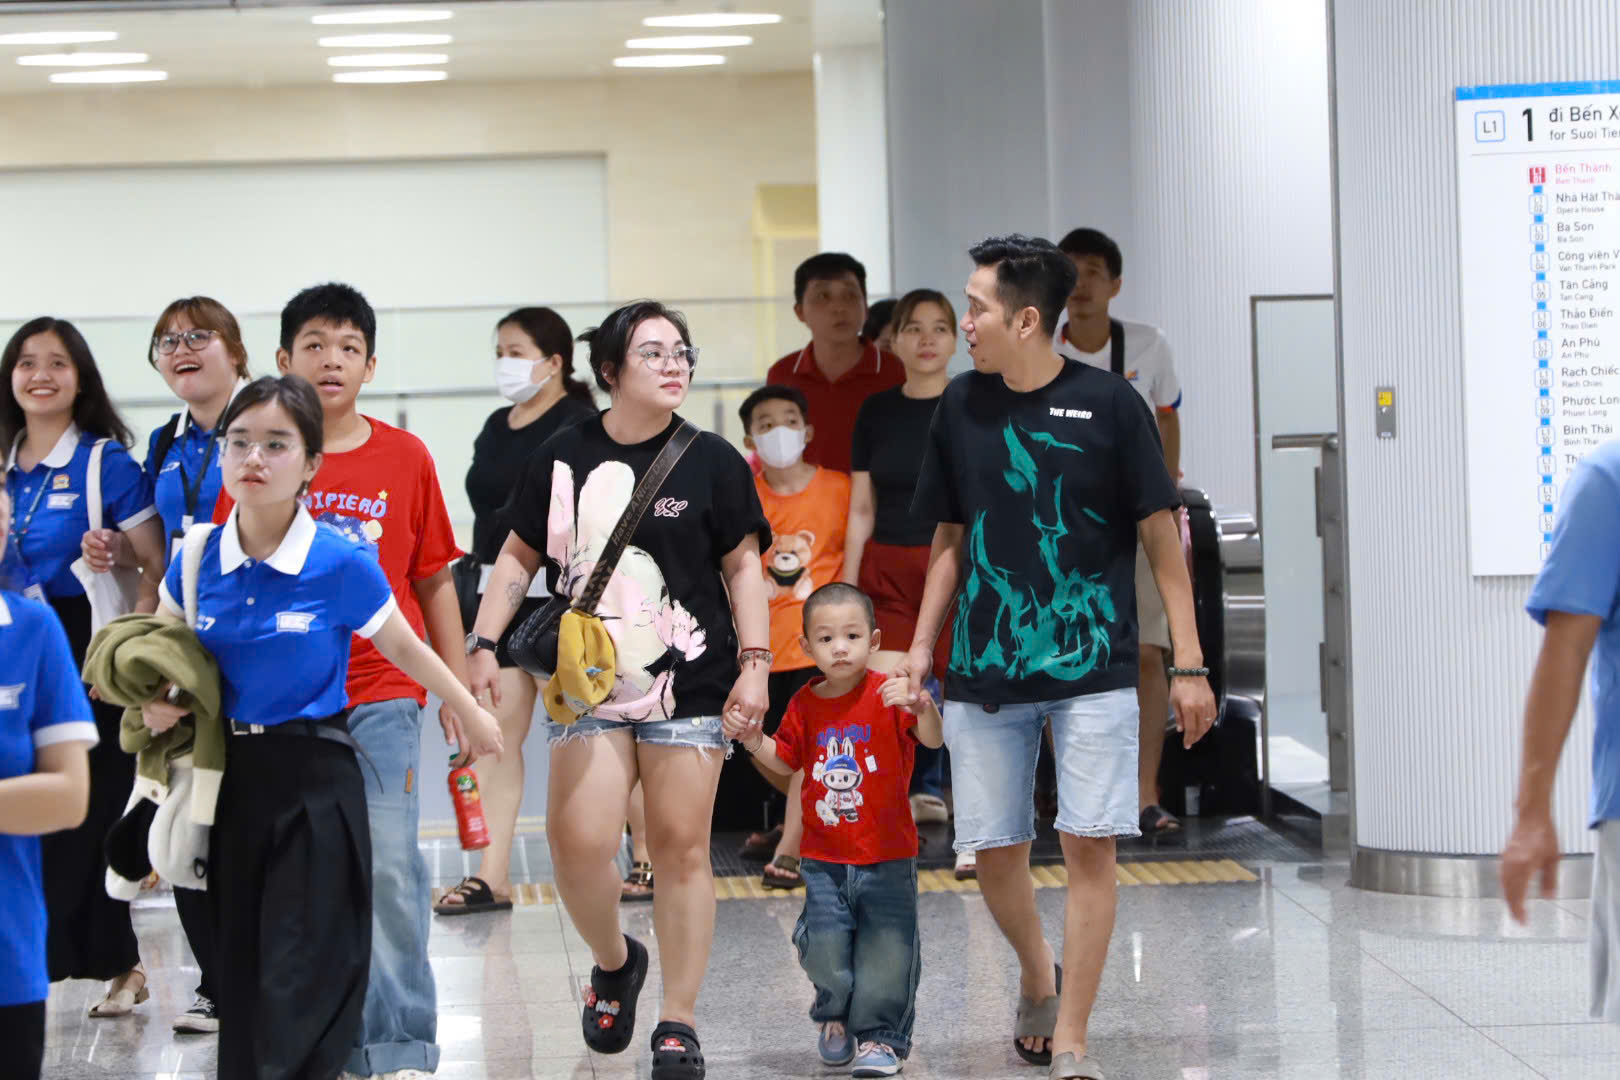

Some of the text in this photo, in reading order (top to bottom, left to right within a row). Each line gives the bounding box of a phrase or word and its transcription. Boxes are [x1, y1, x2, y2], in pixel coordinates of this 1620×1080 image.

[1549, 107, 1564, 123] đi
[1570, 104, 1602, 122] Bến
[1483, 120, 1498, 134] L1
[1522, 107, 1534, 142] 1
[1550, 130, 1566, 141] for
[1571, 128, 1597, 140] Suoi
[1557, 221, 1594, 232] Ba Son
[1558, 250, 1585, 262] Công
[1588, 249, 1610, 260] viên
[1561, 338, 1576, 348] An
[1599, 395, 1620, 405] Lon
[1049, 407, 1093, 419] THE WEIRD
